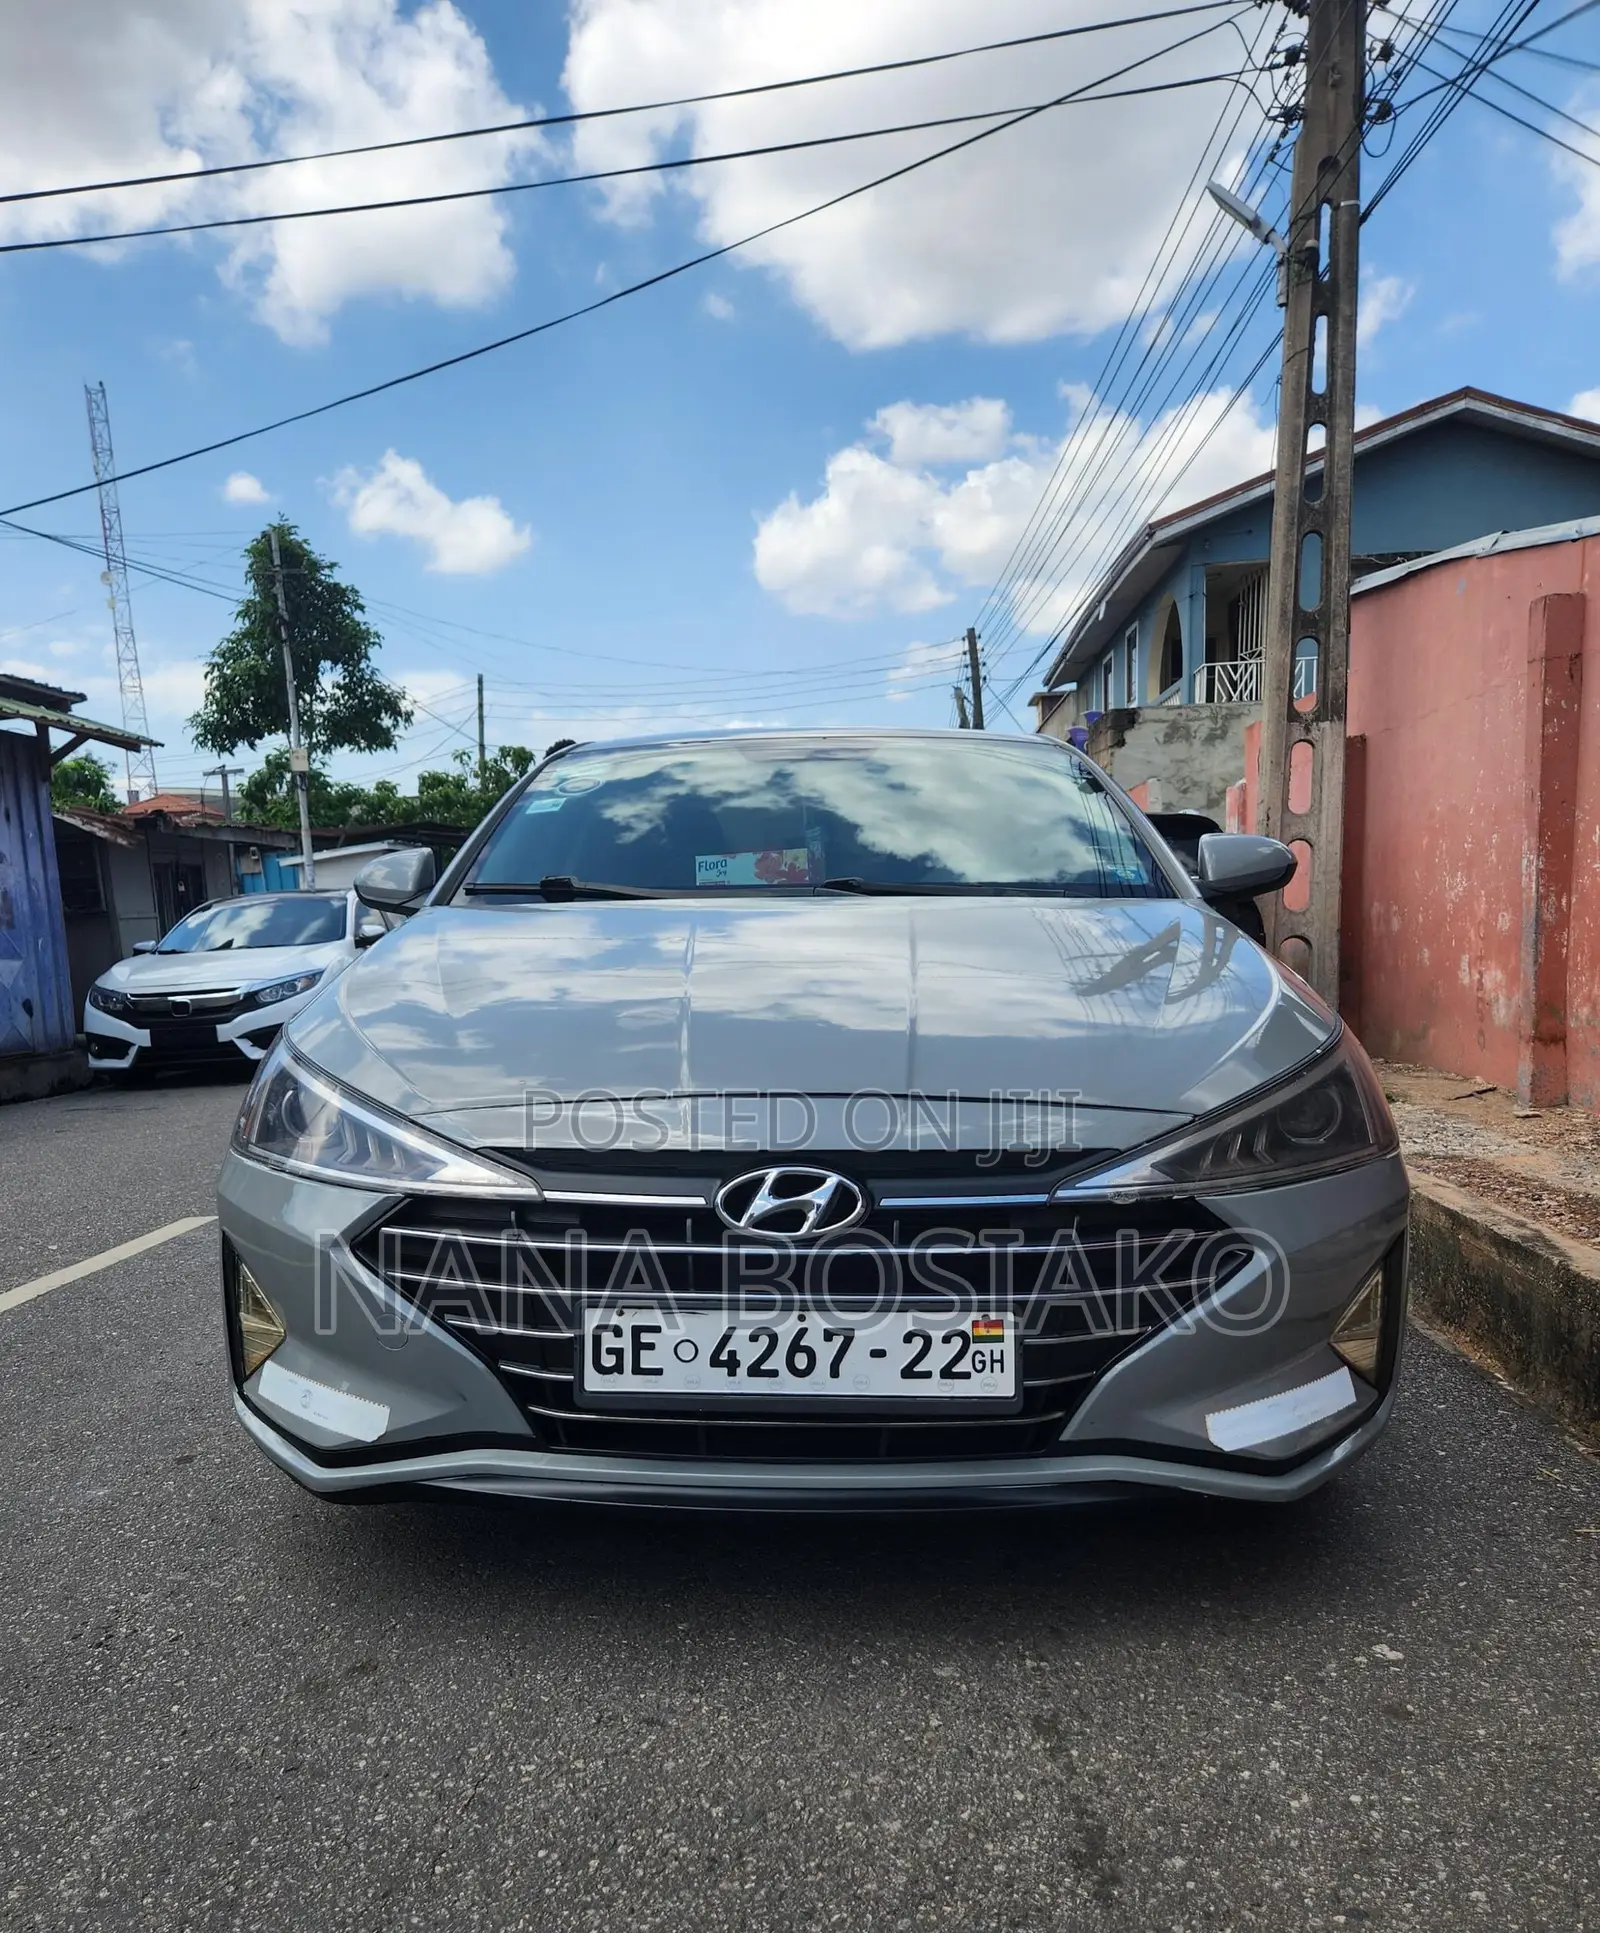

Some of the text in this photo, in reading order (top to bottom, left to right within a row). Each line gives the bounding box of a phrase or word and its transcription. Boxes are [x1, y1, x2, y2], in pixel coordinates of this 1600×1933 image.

[698, 859, 728, 873] Flora
[591, 1325, 664, 1377] GE
[971, 1349, 1005, 1374] GH
